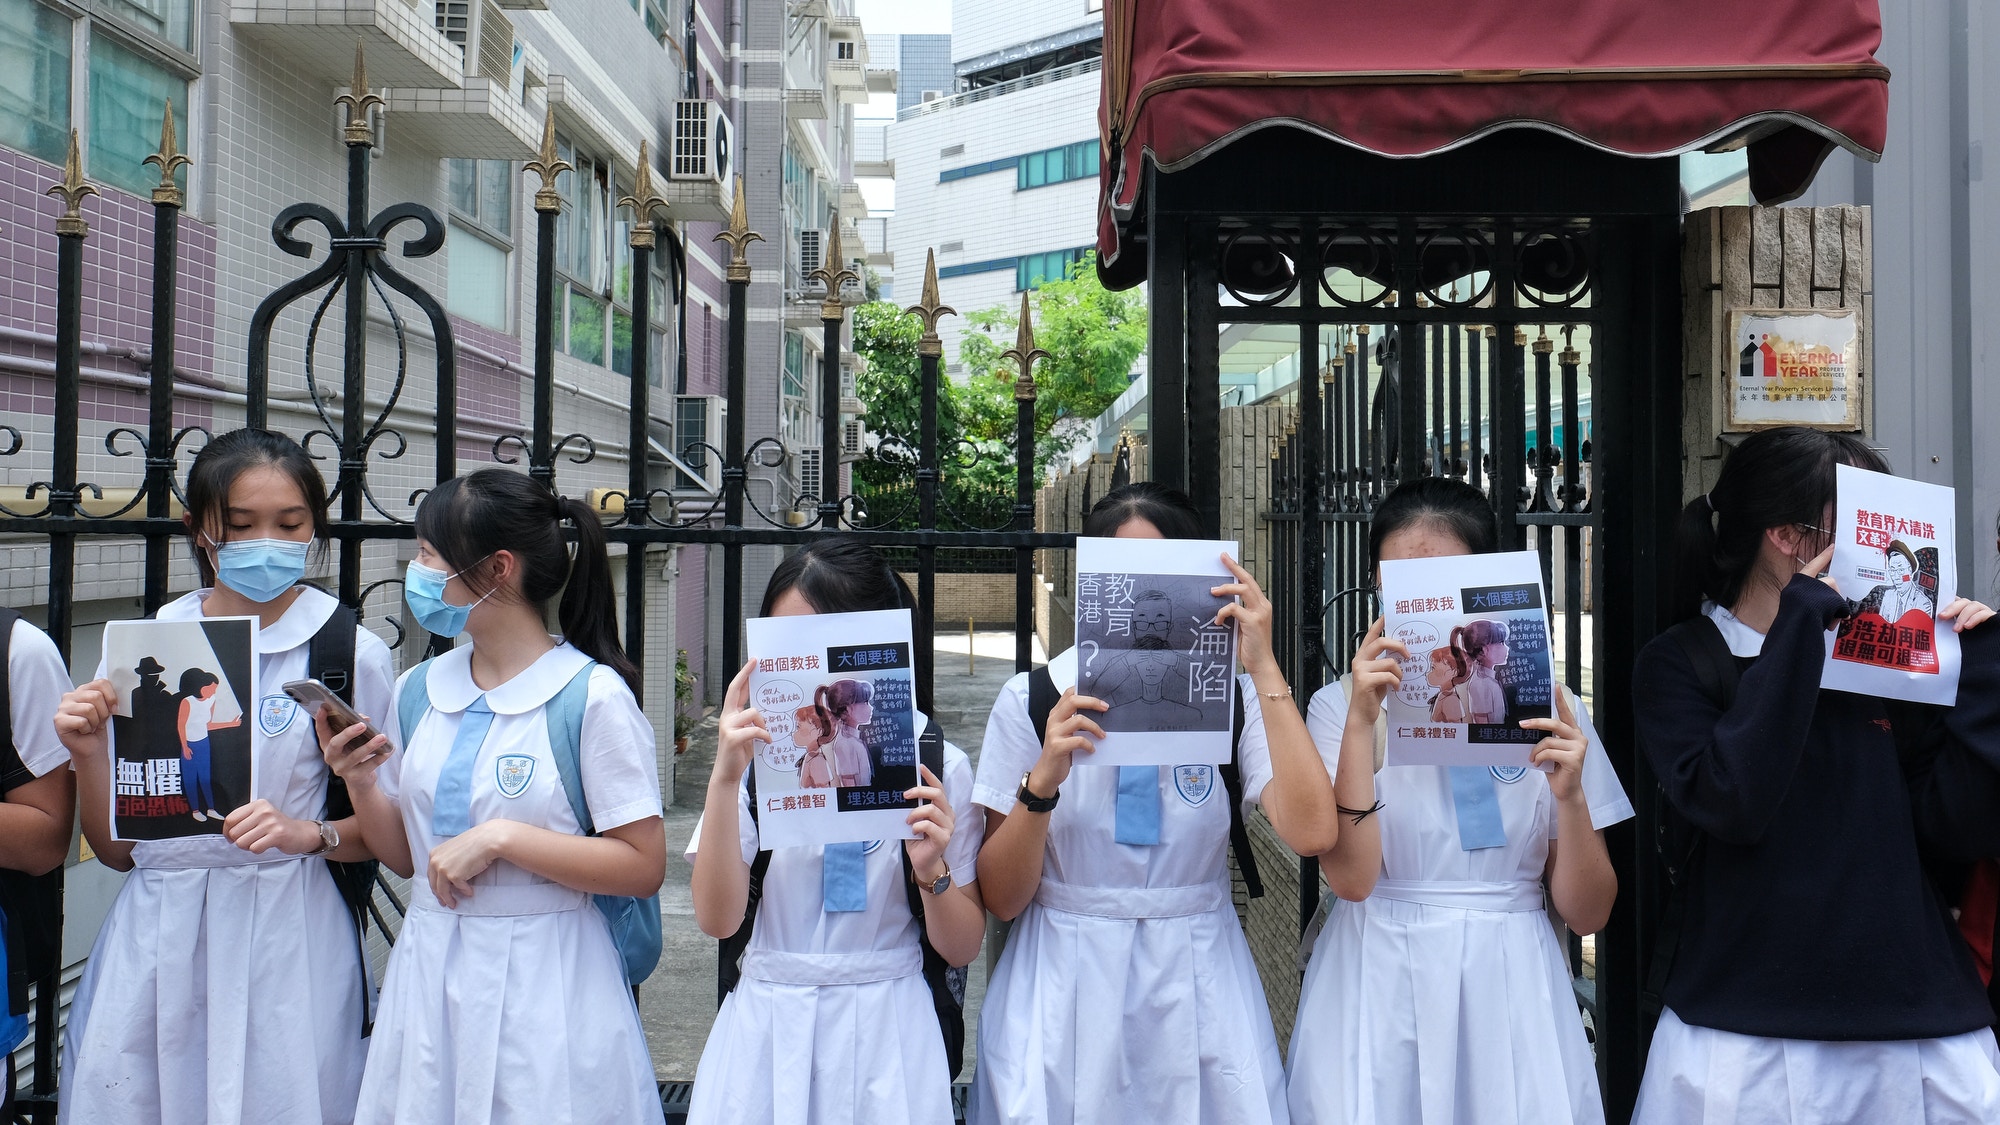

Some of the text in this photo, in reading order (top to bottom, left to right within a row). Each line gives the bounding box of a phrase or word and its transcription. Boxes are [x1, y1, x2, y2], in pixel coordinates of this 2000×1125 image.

[1780, 353, 1845, 364] ETERNAL
[1780, 366, 1819, 378] YEAR
[1740, 393, 1848, 402] 永年物業管理有限公司
[1856, 509, 1935, 540] 教育界大清洗
[1078, 573, 1102, 624] 香港
[1104, 573, 1136, 637] 教育
[1395, 596, 1455, 614] 細個教我
[1471, 590, 1530, 608] 大個要我
[1853, 619, 1931, 651] 浩劫再臨
[837, 649, 898, 667] 大個要我
[1188, 615, 1231, 703] 淪陷
[1837, 638, 1911, 667] 退無可退
[759, 655, 820, 673] 細個教我
[1397, 726, 1457, 739] 仁義禮智
[1478, 728, 1540, 740] 埋沒良知
[117, 758, 183, 796] 無懼
[116, 795, 190, 817] 白色恐怖
[766, 794, 827, 813] 仁義禮智
[847, 790, 907, 806] 埋沒良知
